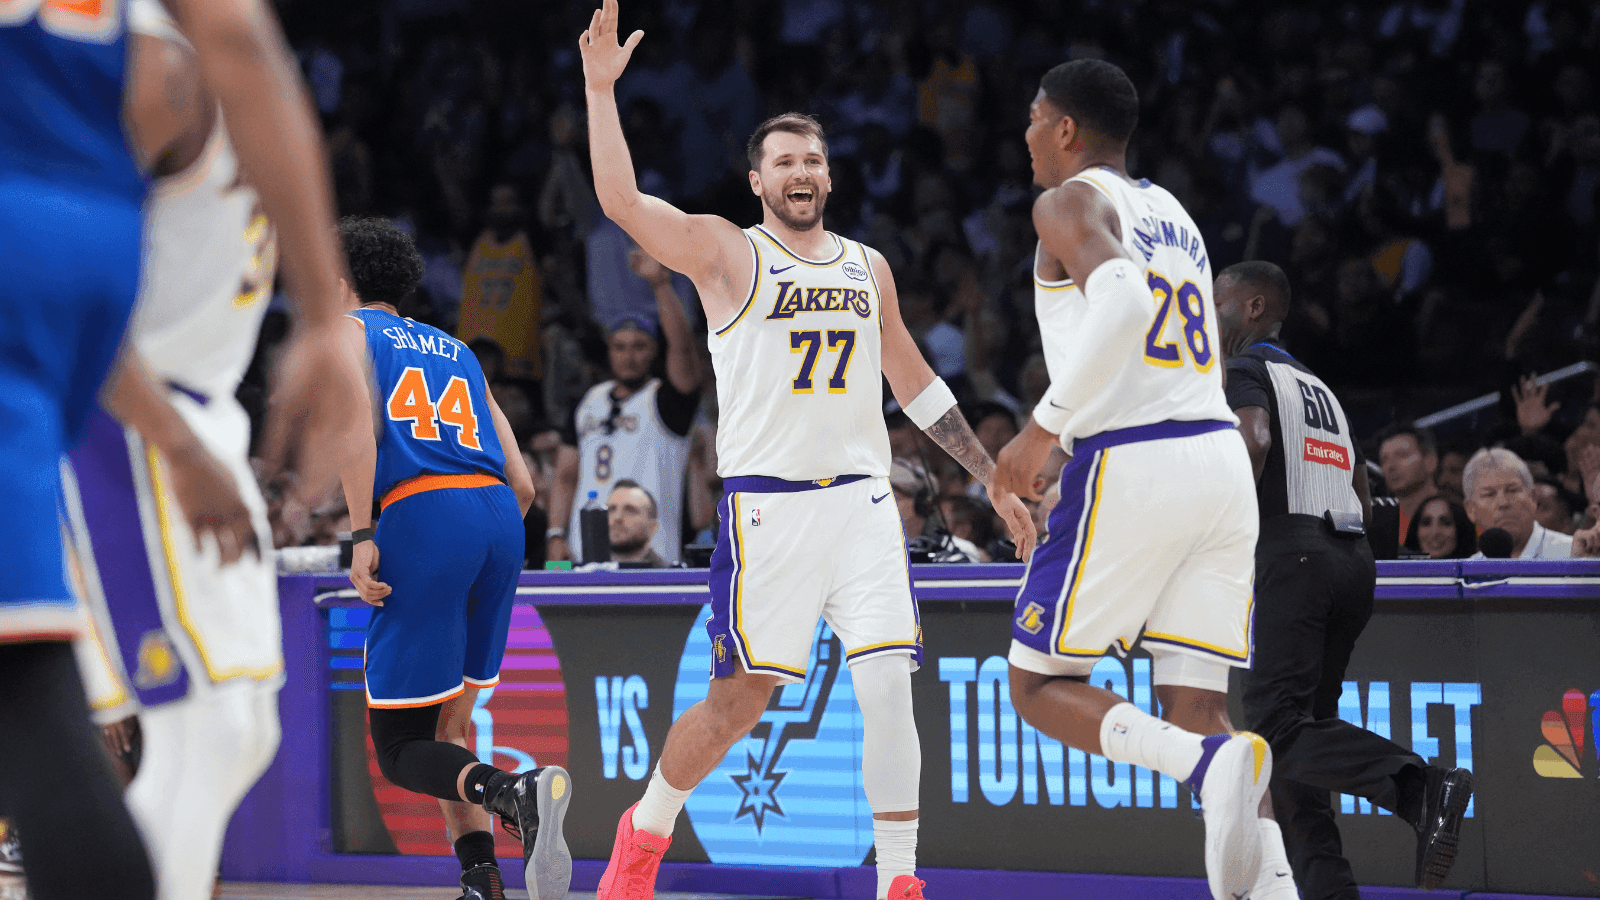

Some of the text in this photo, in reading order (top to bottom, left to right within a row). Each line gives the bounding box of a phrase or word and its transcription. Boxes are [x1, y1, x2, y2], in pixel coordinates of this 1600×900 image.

[1133, 215, 1207, 275] HAMURA
[764, 280, 872, 321] LAKERS
[1143, 268, 1216, 374] 28
[382, 326, 462, 362] SHAMET
[788, 329, 857, 395] 77
[386, 366, 484, 452] 44
[1295, 377, 1341, 435] 60
[595, 443, 614, 485] 8
[1305, 442, 1346, 464] Emirates
[595, 674, 650, 781] VS
[938, 655, 1202, 810] TONGH
